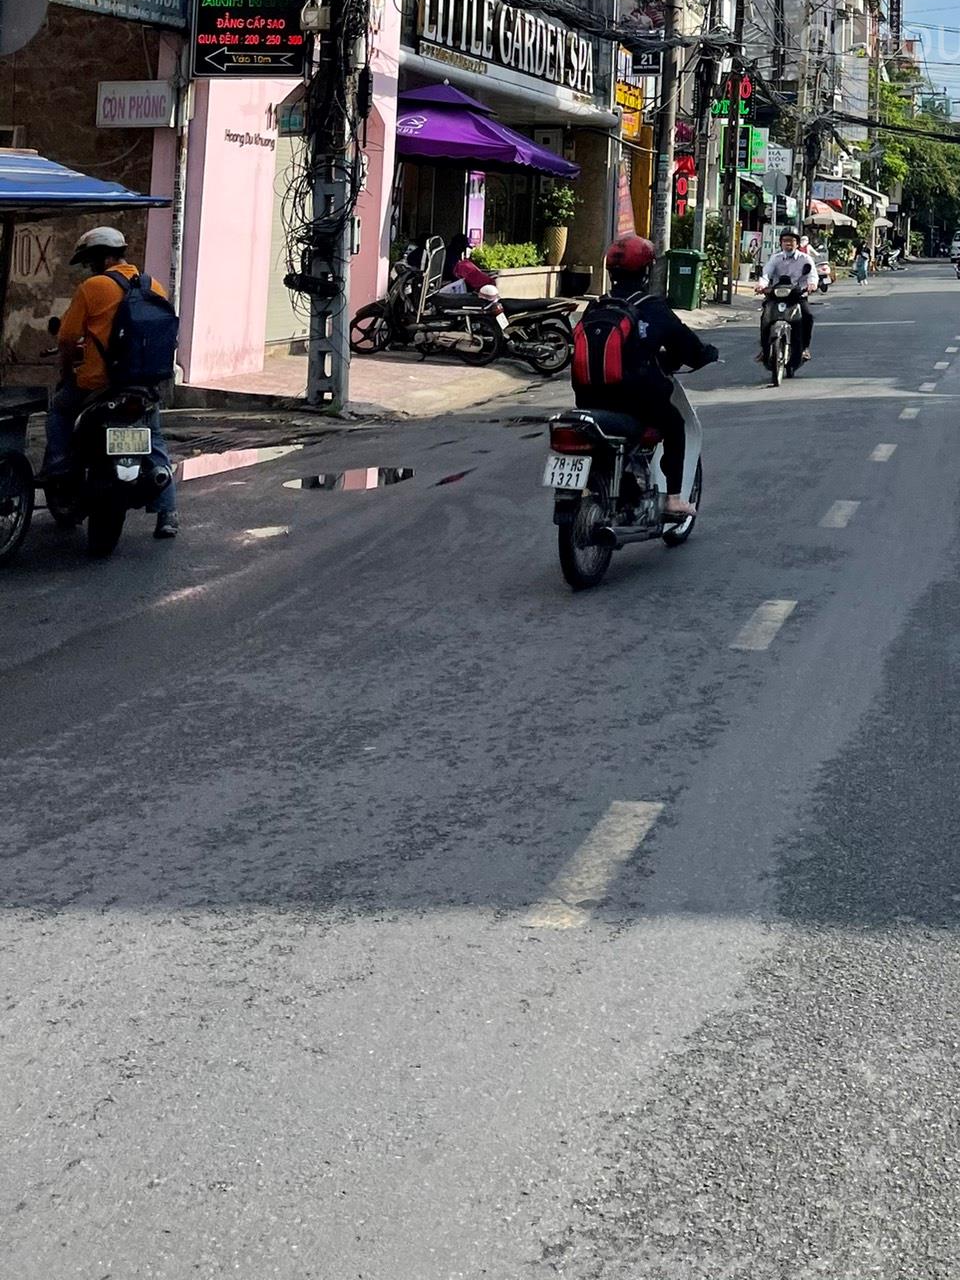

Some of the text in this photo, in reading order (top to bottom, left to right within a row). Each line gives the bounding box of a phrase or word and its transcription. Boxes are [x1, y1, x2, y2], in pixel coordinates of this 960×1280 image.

[267, 19, 286, 29] SAO
[198, 34, 218, 45] QUA
[244, 34, 260, 45] 200
[500, 4, 566, 83] GARDEN
[568, 31, 594, 94] SPA
[253, 55, 272, 63] 10m
[640, 53, 653, 65] 21
[102, 89, 166, 120] CÒN PHÒNG
[550, 471, 580, 487] 1321
